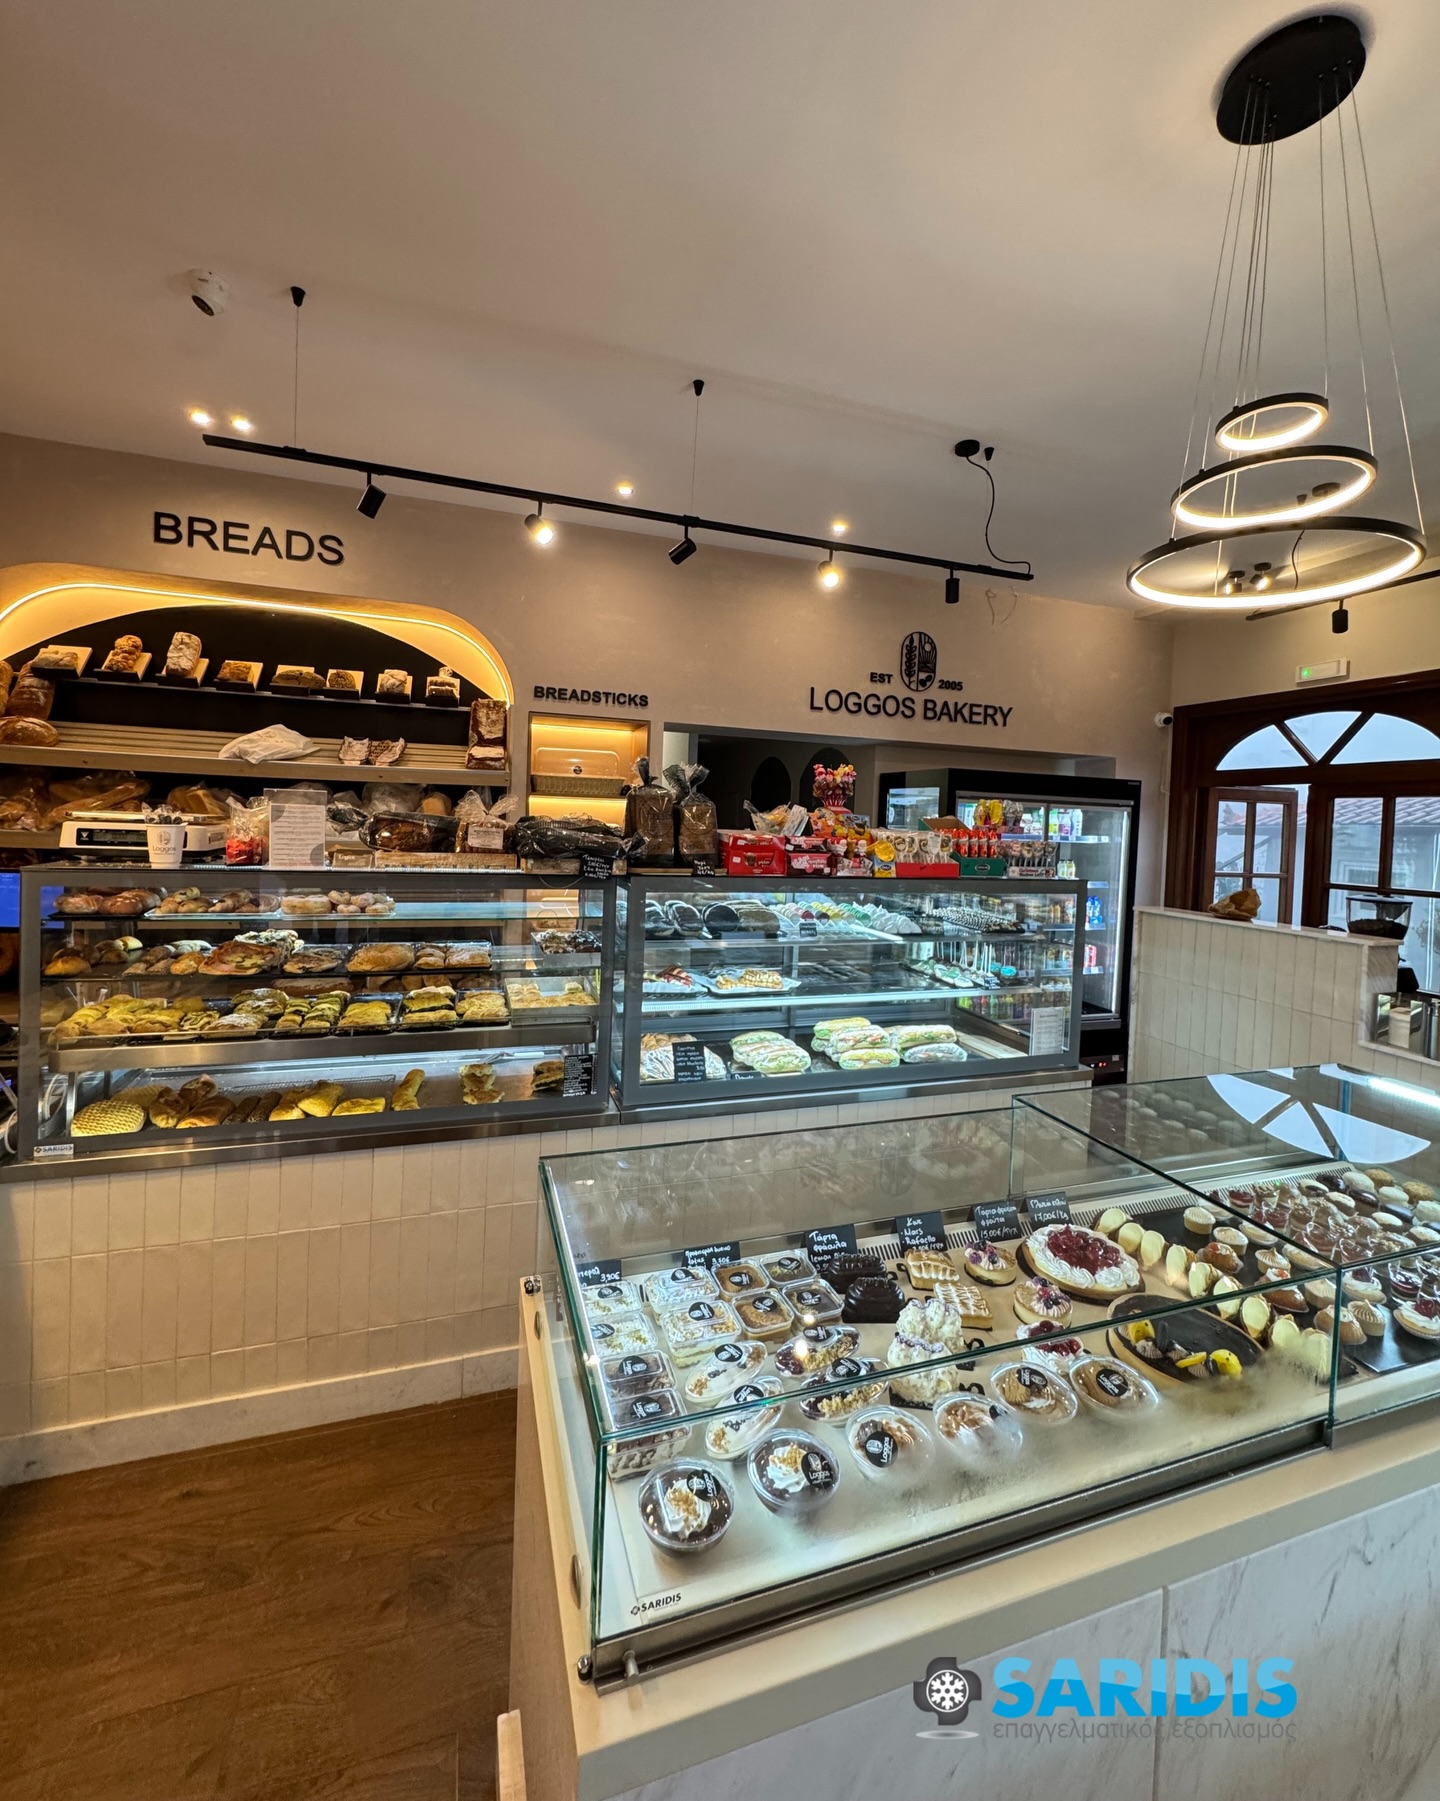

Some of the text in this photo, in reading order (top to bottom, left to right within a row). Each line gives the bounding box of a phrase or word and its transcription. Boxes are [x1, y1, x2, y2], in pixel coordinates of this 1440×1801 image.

[153, 511, 345, 567] BREADS
[869, 672, 964, 692] EST 2005
[533, 685, 650, 708] BREADSTICKS
[809, 686, 1014, 728] LOGGOS BAKERY
[43, 1145, 73, 1153] SARIDIS
[880, 1436, 890, 1463] Loggos
[809, 1470, 830, 1480] Loggos
[641, 1592, 682, 1612] SARIDIS
